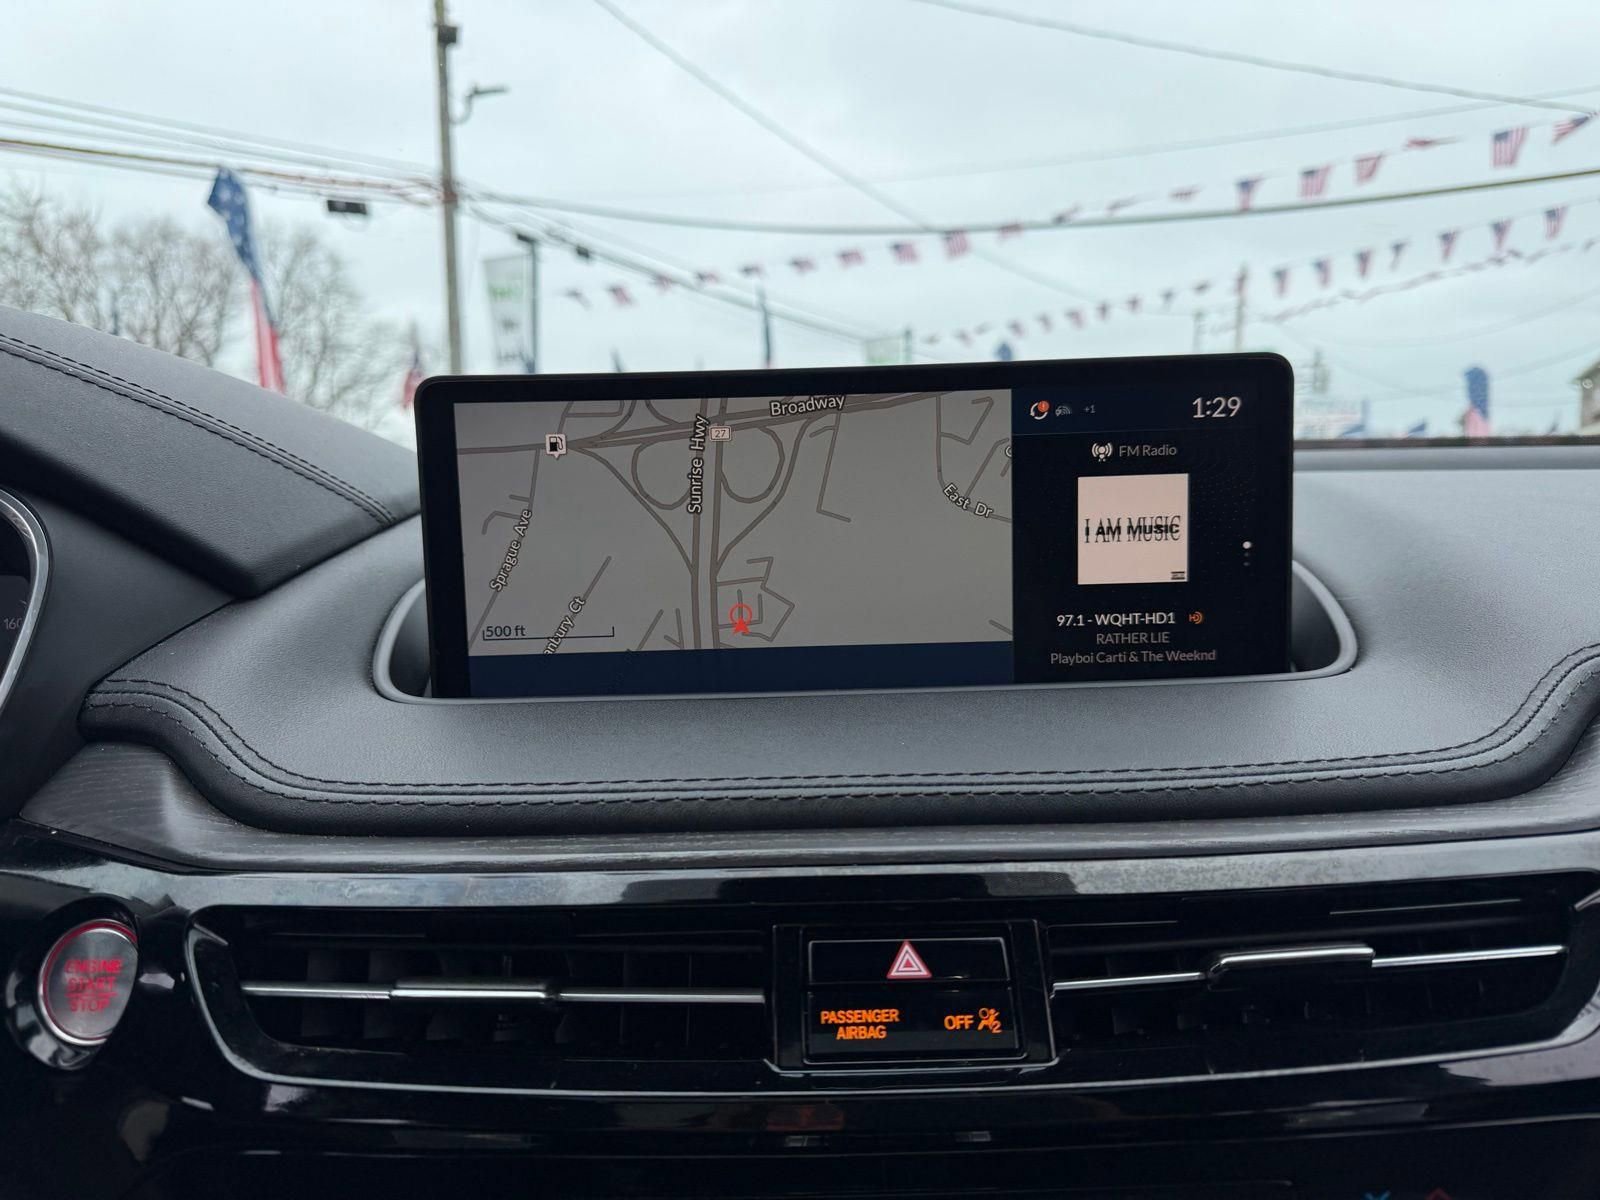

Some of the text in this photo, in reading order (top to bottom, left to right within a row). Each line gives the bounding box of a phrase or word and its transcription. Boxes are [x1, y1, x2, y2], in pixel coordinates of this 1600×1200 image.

[770, 395, 846, 417] Broadway
[1192, 397, 1242, 419] 1:29
[714, 428, 727, 439] 27
[1119, 444, 1177, 456] FM Radio
[687, 415, 709, 514] Sunrise Hwy
[943, 483, 994, 518] East Dr
[1084, 515, 1181, 543] I AM MUSIC
[490, 509, 532, 592] Sprague Ave
[569, 596, 586, 614] Ct
[1056, 614, 1085, 627] 97.1
[1094, 612, 1176, 627] WQHT-HD1
[485, 625, 526, 637] 500 ft
[1096, 631, 1171, 645] RATHER LIE
[1050, 649, 1216, 666] Playboi Carti & The Weeknd
[69, 998, 110, 1013] STOP
[820, 1009, 900, 1025] PASSENGER
[943, 1015, 974, 1031] OFF
[836, 1025, 887, 1041] AIRBAG
